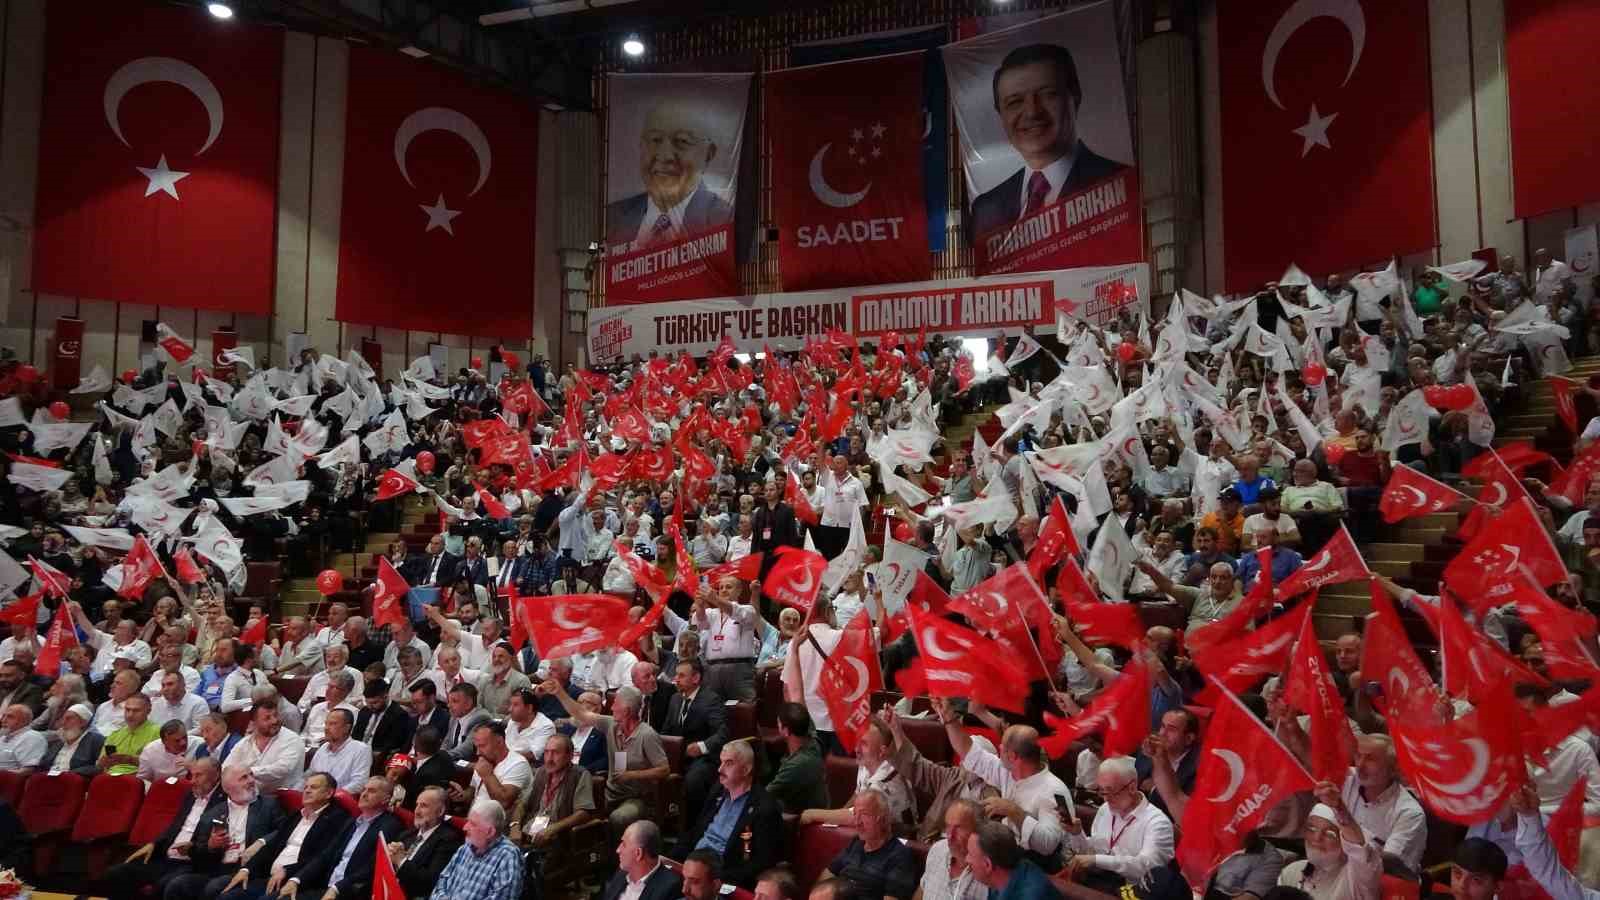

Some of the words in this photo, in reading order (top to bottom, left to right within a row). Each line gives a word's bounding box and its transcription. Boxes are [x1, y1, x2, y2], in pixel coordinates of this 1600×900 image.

[797, 217, 904, 248] SAADET
[986, 207, 1061, 262] MAHMUT
[1065, 176, 1127, 228] ARIKAN
[654, 308, 763, 345] TÜRKİYE'YE
[768, 302, 847, 340] BAŞKAN
[860, 295, 955, 331] MAHMUT
[961, 287, 1041, 324] ARIKAN
